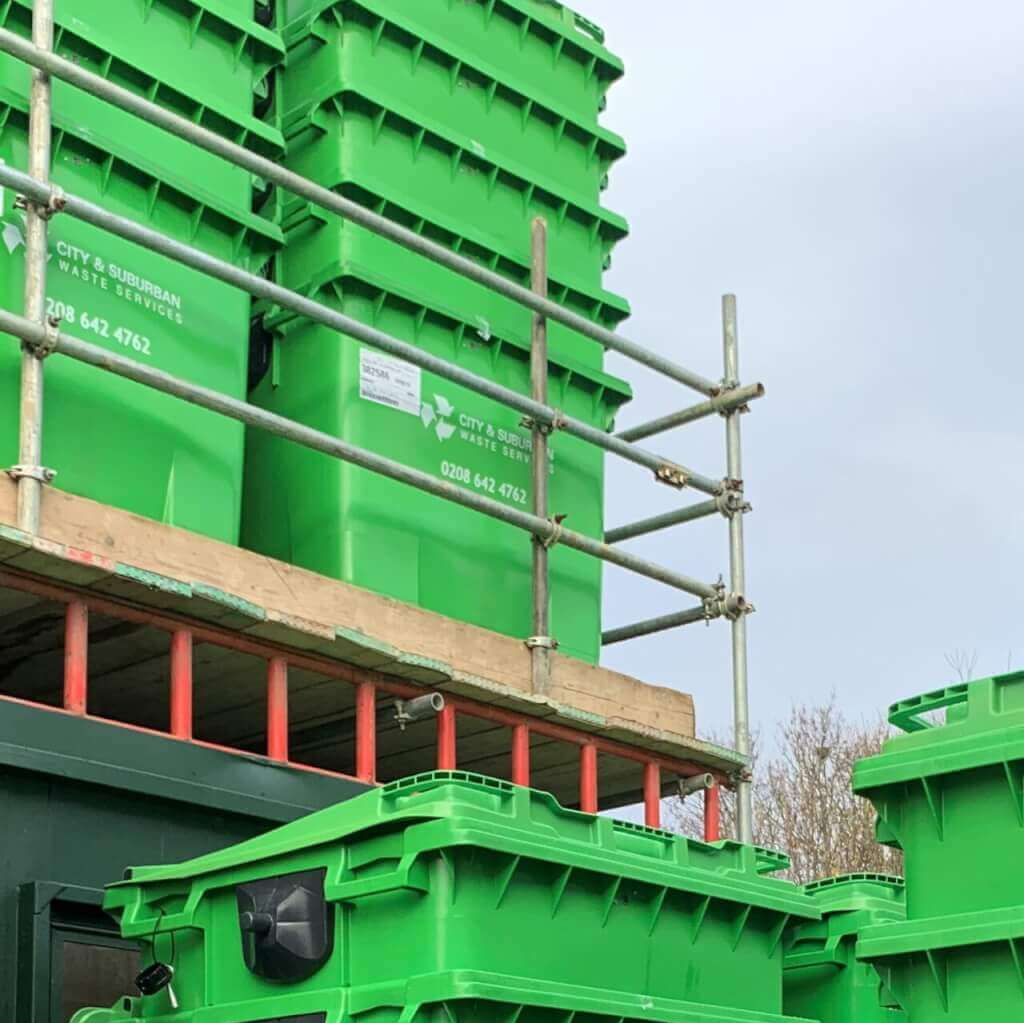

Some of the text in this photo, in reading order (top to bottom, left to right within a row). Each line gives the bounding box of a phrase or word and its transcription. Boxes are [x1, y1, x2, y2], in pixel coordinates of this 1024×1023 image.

[56, 241, 181, 309] CITY & SUBURBAN
[59, 260, 183, 324] WASTE SERVICES
[46, 297, 151, 355] 208 642 4762
[459, 413, 554, 461] CITY & SUBURN
[460, 430, 554, 475] WASTE SERVS
[440, 460, 527, 504] 0208 642 4762
